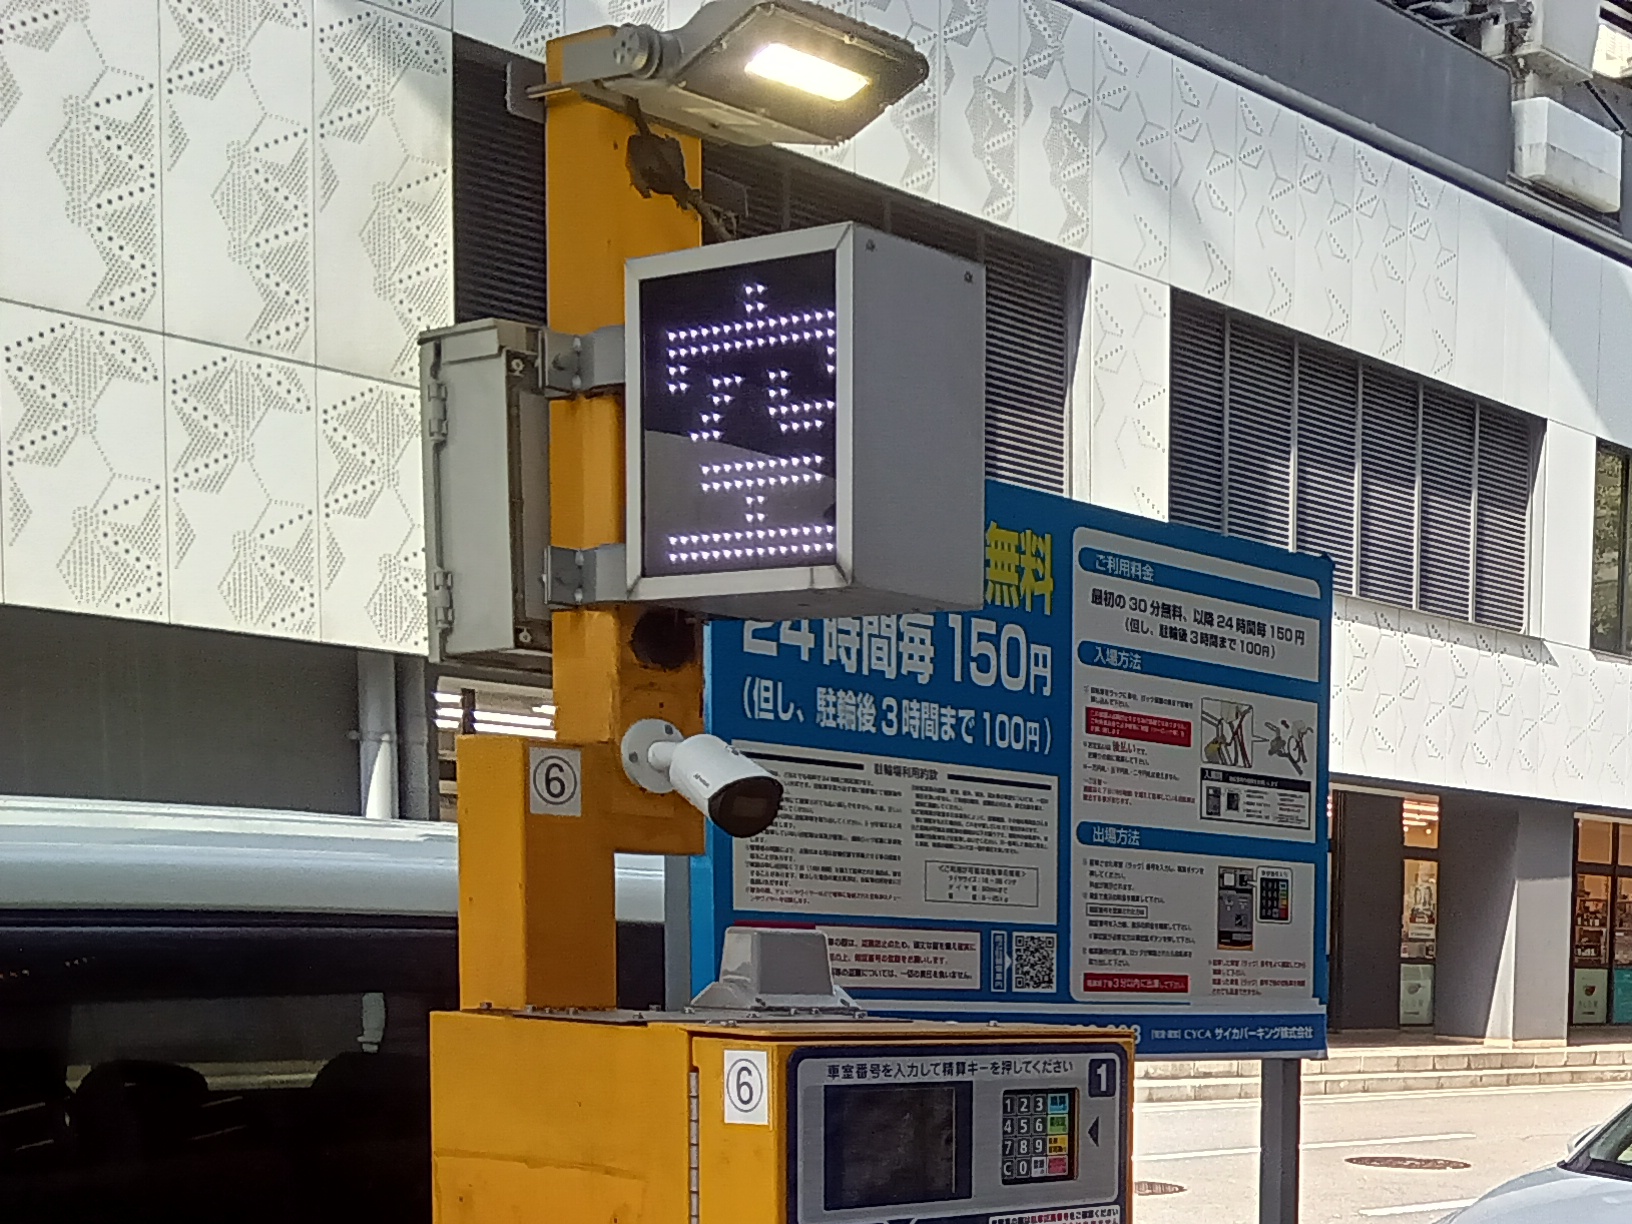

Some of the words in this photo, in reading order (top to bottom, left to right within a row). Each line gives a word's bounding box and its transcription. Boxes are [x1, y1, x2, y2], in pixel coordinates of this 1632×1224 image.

[666, 282, 838, 566] 空
[1095, 553, 1155, 583] ご利用料金
[1094, 645, 1143, 672] 入場方法
[1092, 826, 1141, 847] 出場方法
[1184, 1029, 1212, 1040] CYCA
[826, 1060, 1074, 1081] 車室番号を入力して精算キーを押してください
[1096, 1063, 1108, 1092] 1
[1005, 1098, 1012, 1113] 1
[1020, 1098, 1028, 1112] 2
[1035, 1097, 1043, 1111] 3
[1004, 1120, 1012, 1134] 4
[1020, 1119, 1028, 1133] 5
[1035, 1118, 1043, 1132] 6
[1004, 1140, 1012, 1155] 7
[1019, 1140, 1028, 1154] 8
[1035, 1139, 1042, 1153] 9
[1019, 1160, 1028, 1175] 0
